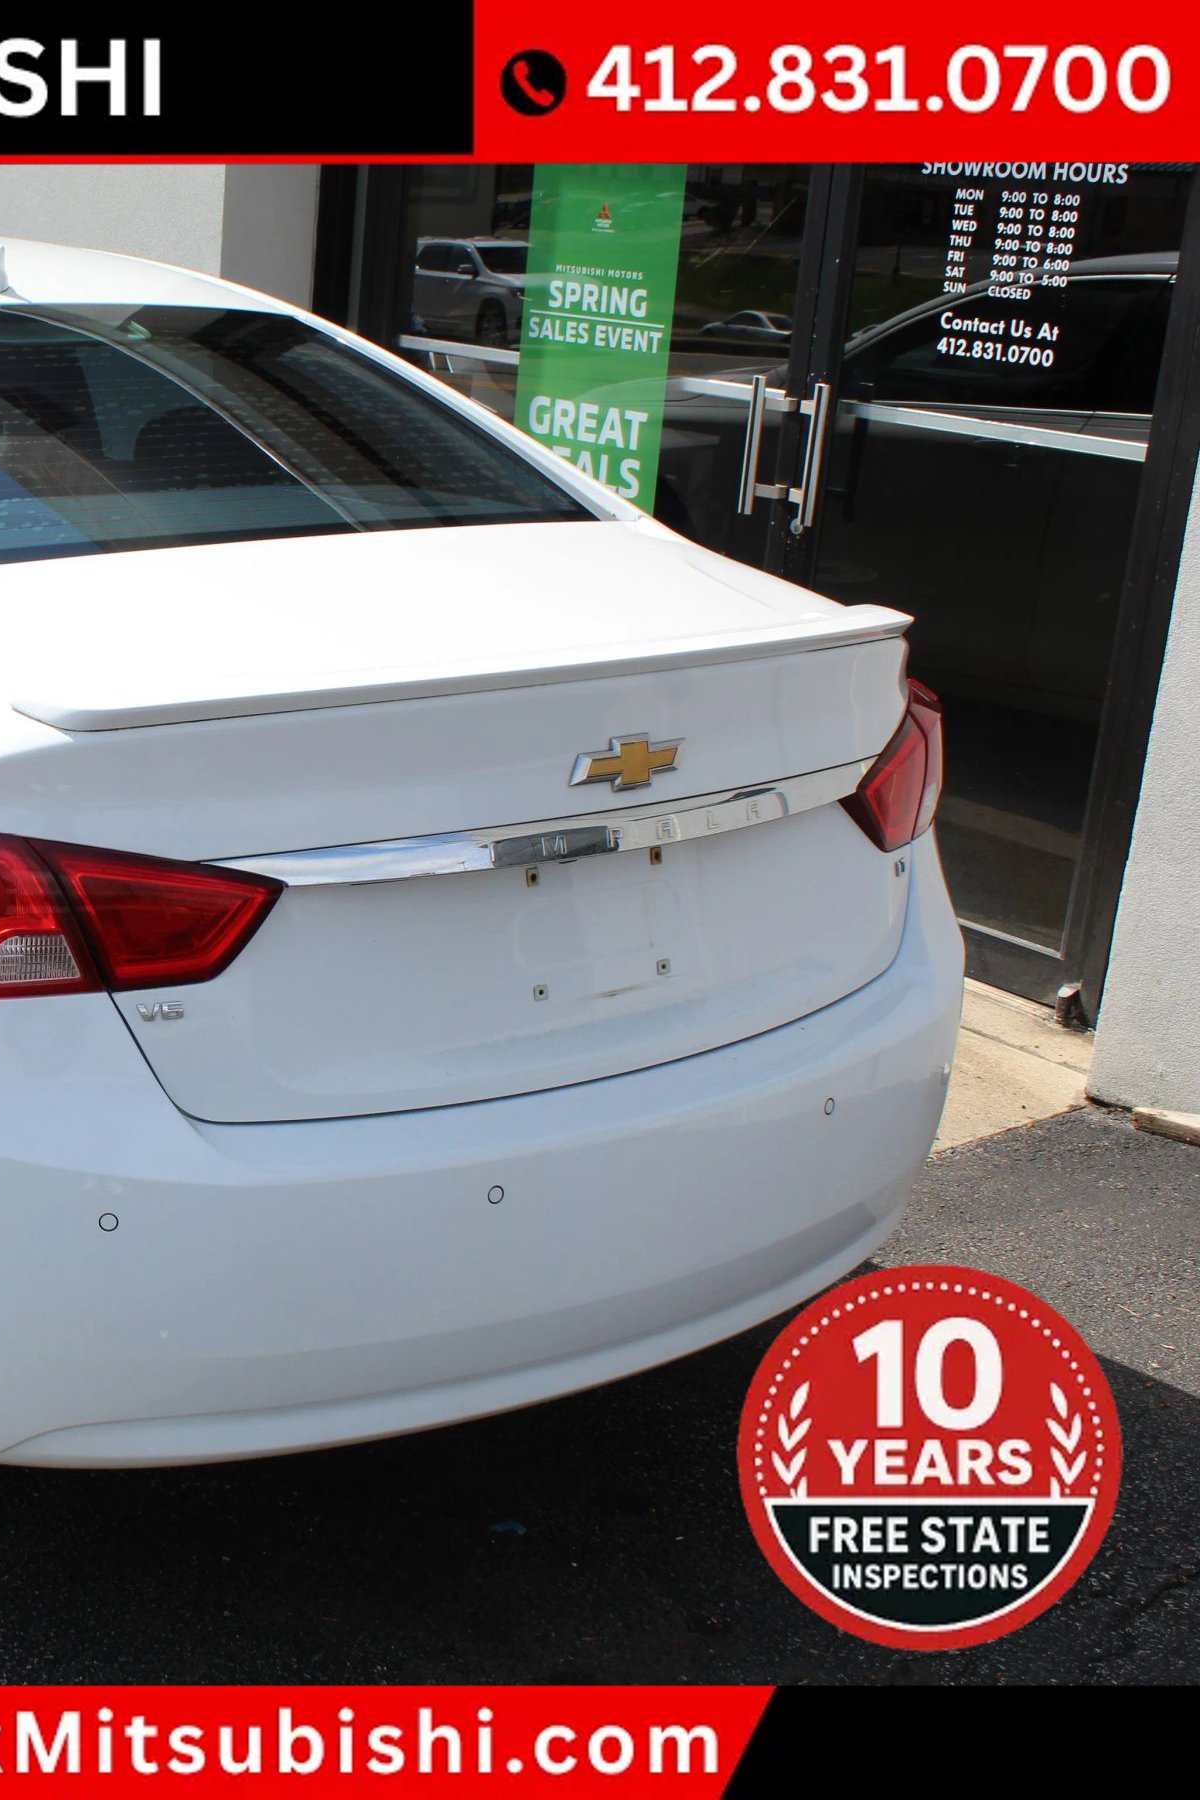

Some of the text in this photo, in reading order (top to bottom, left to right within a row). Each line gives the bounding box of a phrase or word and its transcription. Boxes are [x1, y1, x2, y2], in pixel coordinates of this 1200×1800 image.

[921, 162, 1129, 184] SHOWROOM HOURS
[955, 188, 1080, 207] MON 9:00 TO 8:00
[953, 203, 1078, 223] TUE 9:00 TO 8:00
[951, 219, 1075, 239] WED 9:00 TO 8:00
[949, 234, 1073, 256] THU 9:00 TO 8:00
[555, 264, 644, 280] MITSUBISHI MOTORS
[947, 250, 1070, 272] FRI 9:00 TO 6:00
[945, 265, 1068, 288] SAT 9:00 TO 5:00
[548, 280, 648, 318] SPRING
[943, 281, 1031, 301] SUN CLOSED
[528, 316, 664, 354] SALES EVENT
[940, 311, 1060, 342] Contact Us At
[936, 337, 1054, 368] 412.831.0700
[528, 395, 649, 451] GREAT
[136, 1001, 185, 1022] V6
